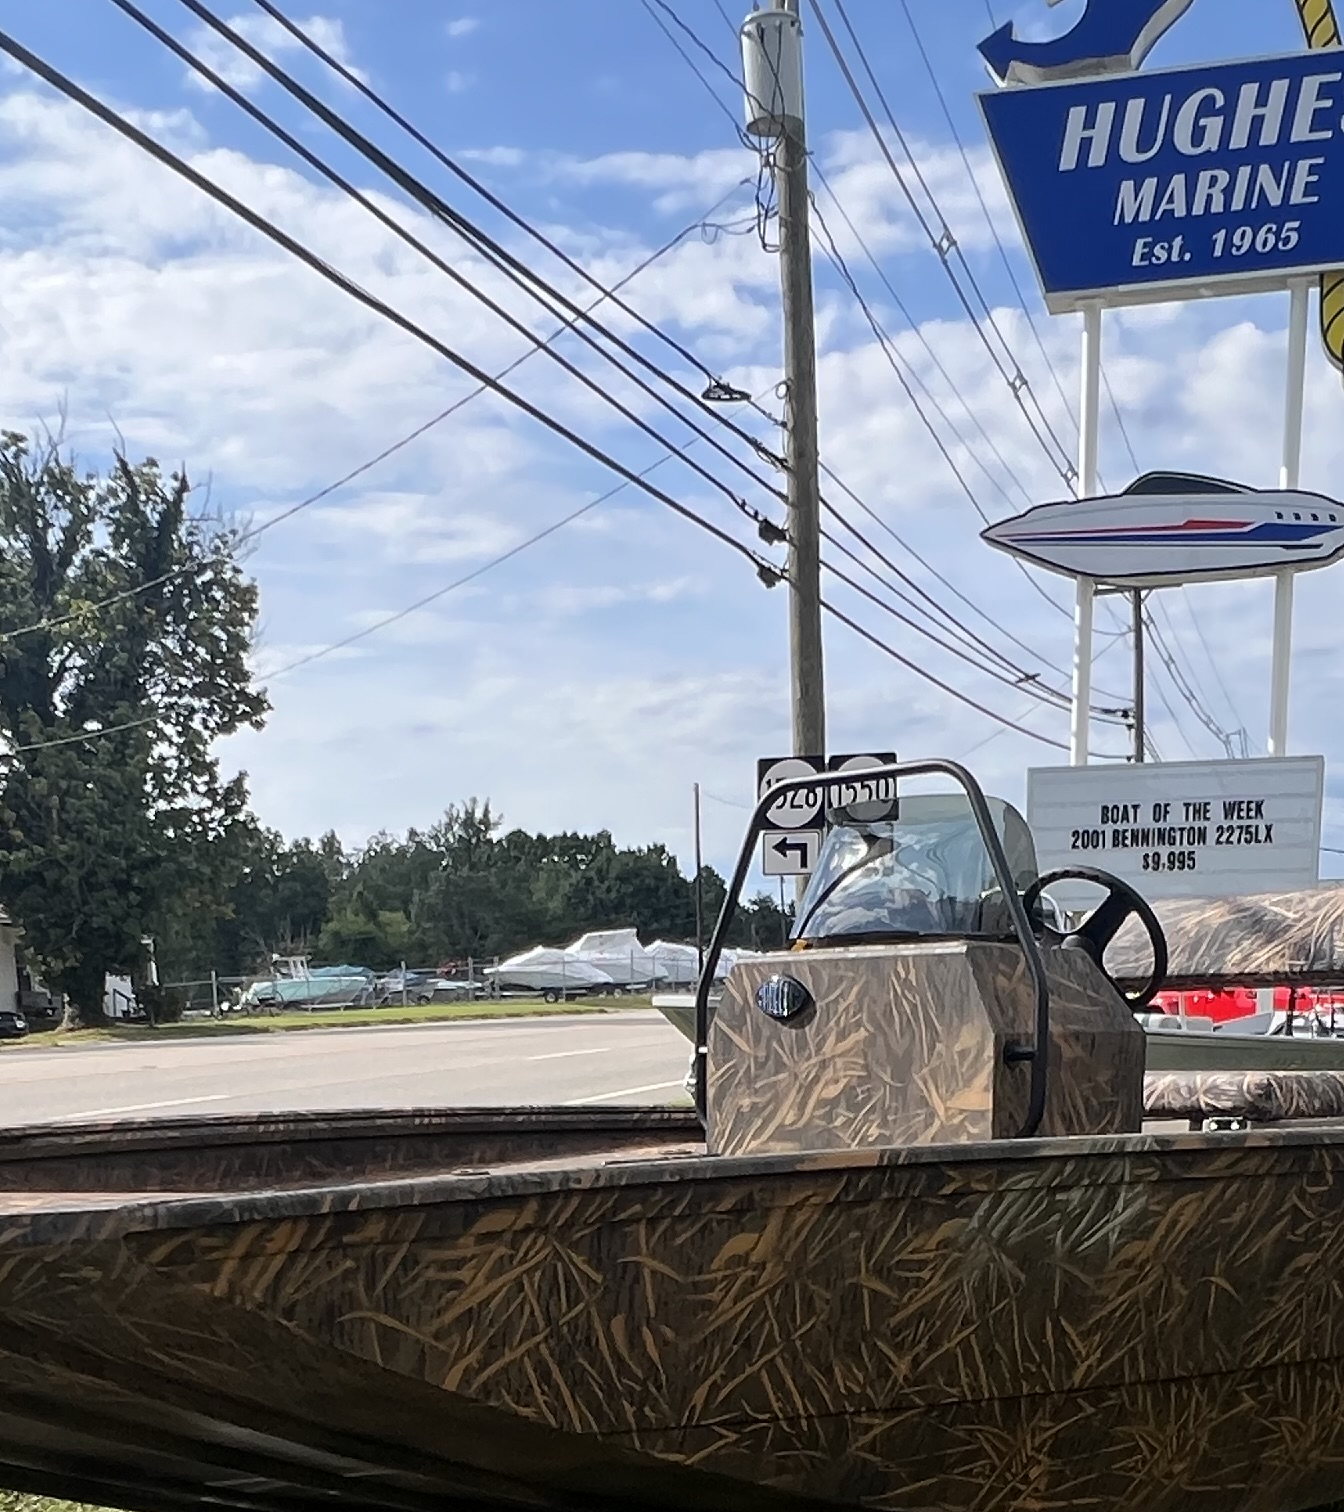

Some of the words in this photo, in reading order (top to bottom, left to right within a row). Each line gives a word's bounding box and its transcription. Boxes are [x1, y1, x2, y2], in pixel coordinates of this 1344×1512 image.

[1114, 157, 1325, 225] MARINE
[1132, 236, 1192, 266] Est.
[1211, 221, 1301, 259] 1965
[1100, 804, 1141, 825] BOAT
[1152, 802, 1171, 823] OF
[1182, 801, 1211, 822] THE
[1222, 799, 1265, 821] WEEK
[1071, 829, 1106, 850] 2001
[1112, 826, 1207, 848] BENNINGTON
[1215, 824, 1273, 846] 2275LX
[1142, 850, 1196, 871] $9,995
